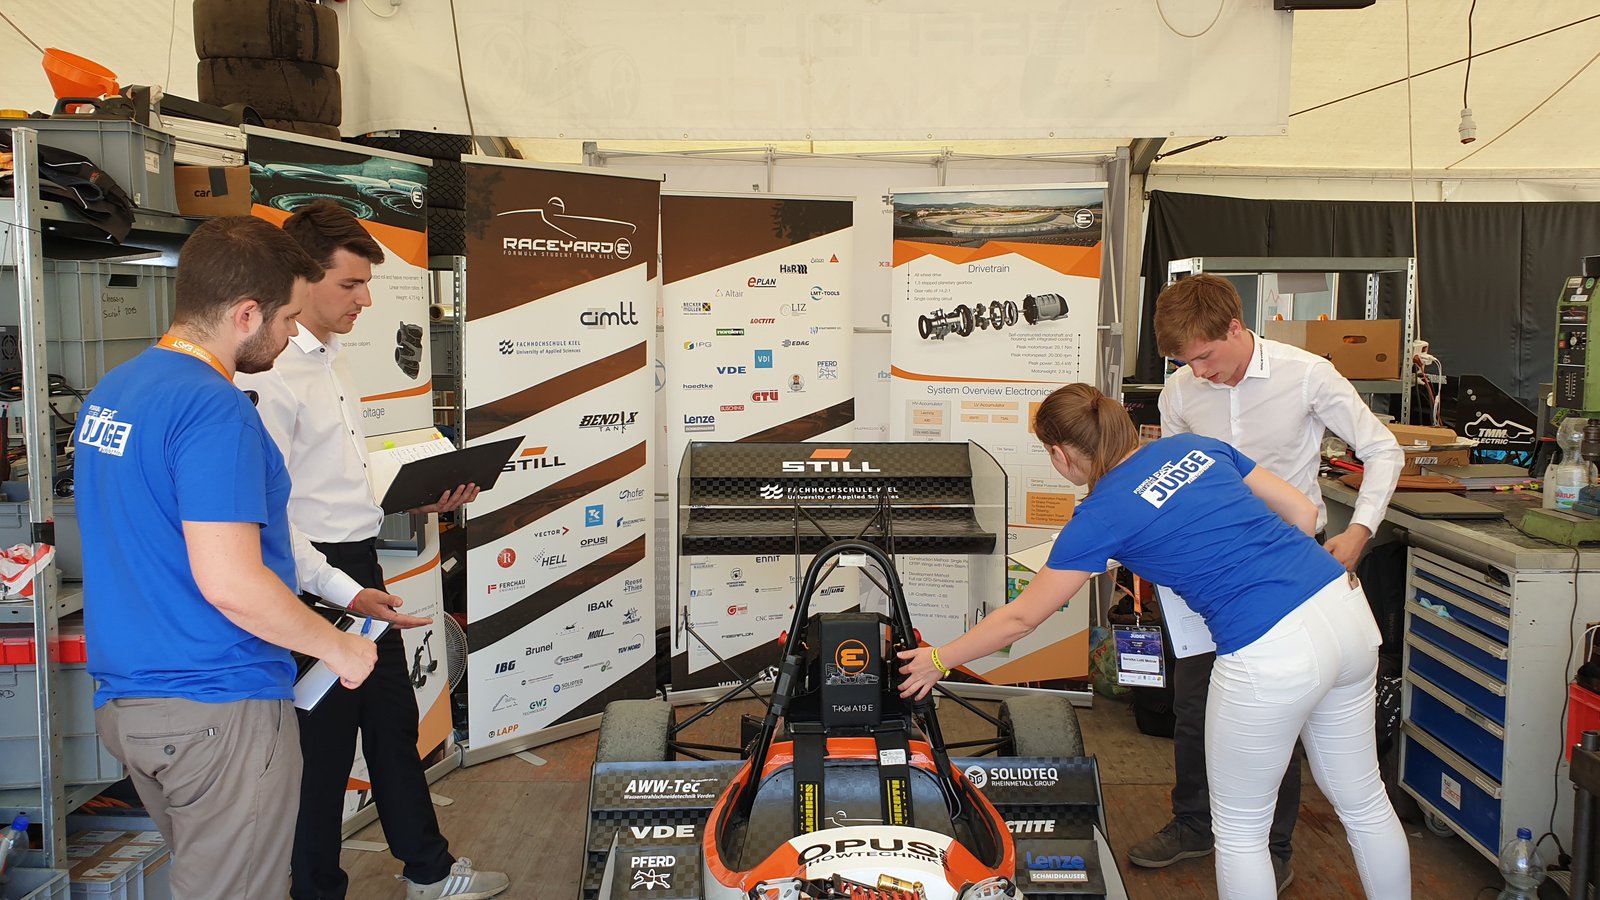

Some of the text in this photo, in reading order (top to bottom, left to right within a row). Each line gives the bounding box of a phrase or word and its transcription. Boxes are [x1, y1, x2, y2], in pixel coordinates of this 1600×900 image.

[503, 238, 614, 254] RACEYARD
[968, 264, 1010, 273] Drivetrain
[725, 289, 744, 298] Altair
[717, 366, 746, 374] VDE
[752, 390, 778, 401] GTÜ
[927, 385, 1054, 395] System Overview Electronics
[362, 407, 385, 418] oltage
[684, 415, 715, 423] Lenze
[82, 419, 126, 448] JUGE
[1478, 428, 1508, 438] TMM
[782, 461, 880, 472] STILL
[1150, 452, 1208, 502] JUDGE
[534, 529, 561, 538] VECTOR
[580, 537, 605, 546] OPUS
[542, 554, 567, 566] HELL
[756, 555, 780, 564] ENNIT
[499, 579, 526, 588] FERCHAU
[625, 578, 642, 586] Reese
[587, 599, 613, 612] IBAK
[588, 629, 605, 640] MOLL
[526, 642, 553, 656] Brunel
[495, 660, 516, 674] IBG
[496, 724, 519, 736] LAPP
[990, 768, 1058, 781] SOLIDTEQ
[625, 780, 700, 793] AWW-Tec
[805, 784, 813, 832] SCHROT
[630, 824, 695, 839] VDE
[1004, 820, 1055, 833] CTITE
[798, 838, 938, 865] OPUS
[630, 856, 675, 868] PFERD
[1026, 850, 1085, 869] Lenze
